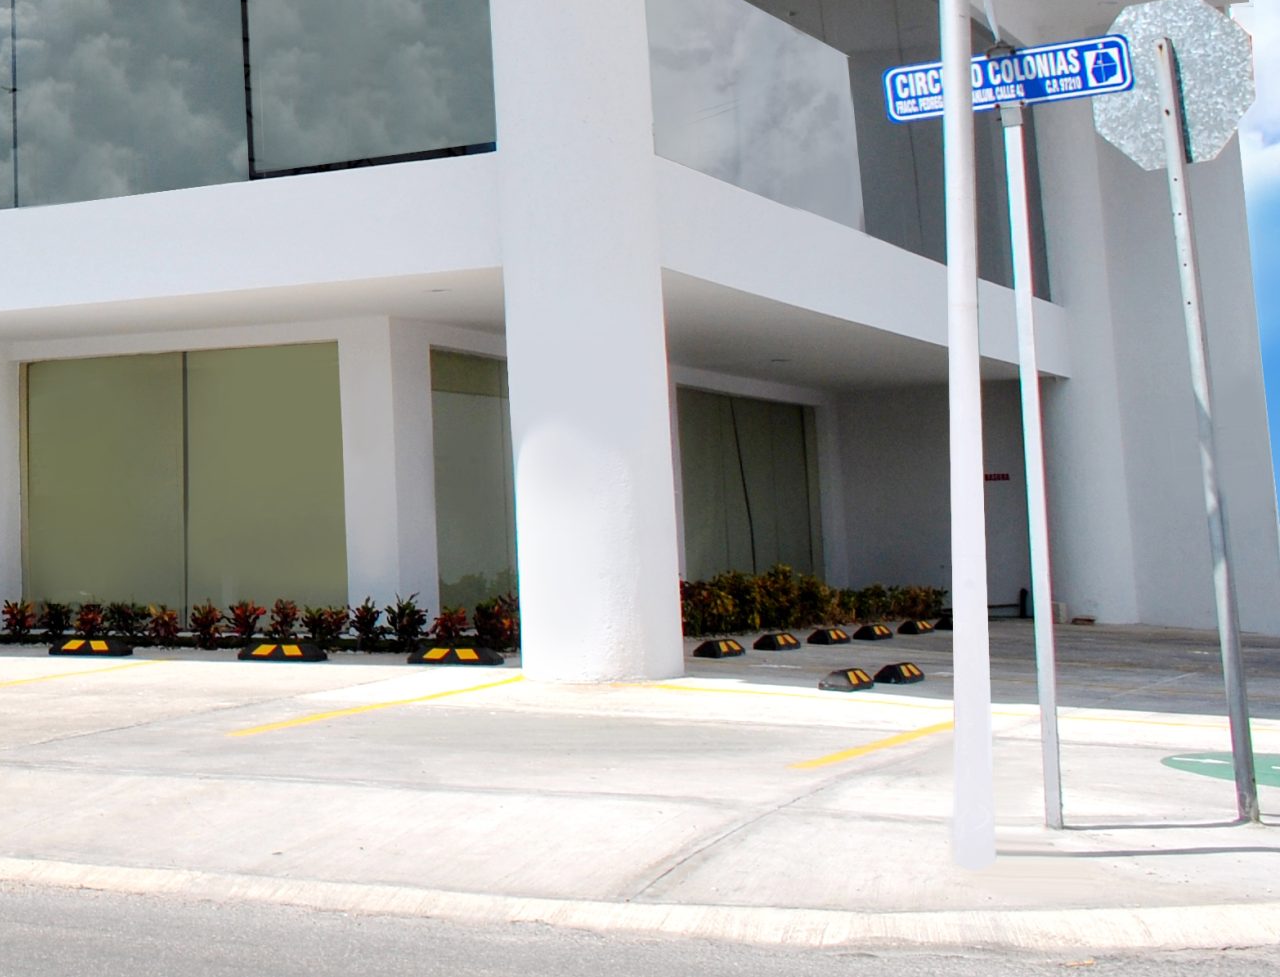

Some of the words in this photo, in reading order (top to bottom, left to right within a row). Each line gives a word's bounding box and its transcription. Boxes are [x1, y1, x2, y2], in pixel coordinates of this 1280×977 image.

[896, 63, 983, 98] CIRCO
[987, 50, 1080, 84] COLONIAS
[995, 84, 1017, 101] CALLE
